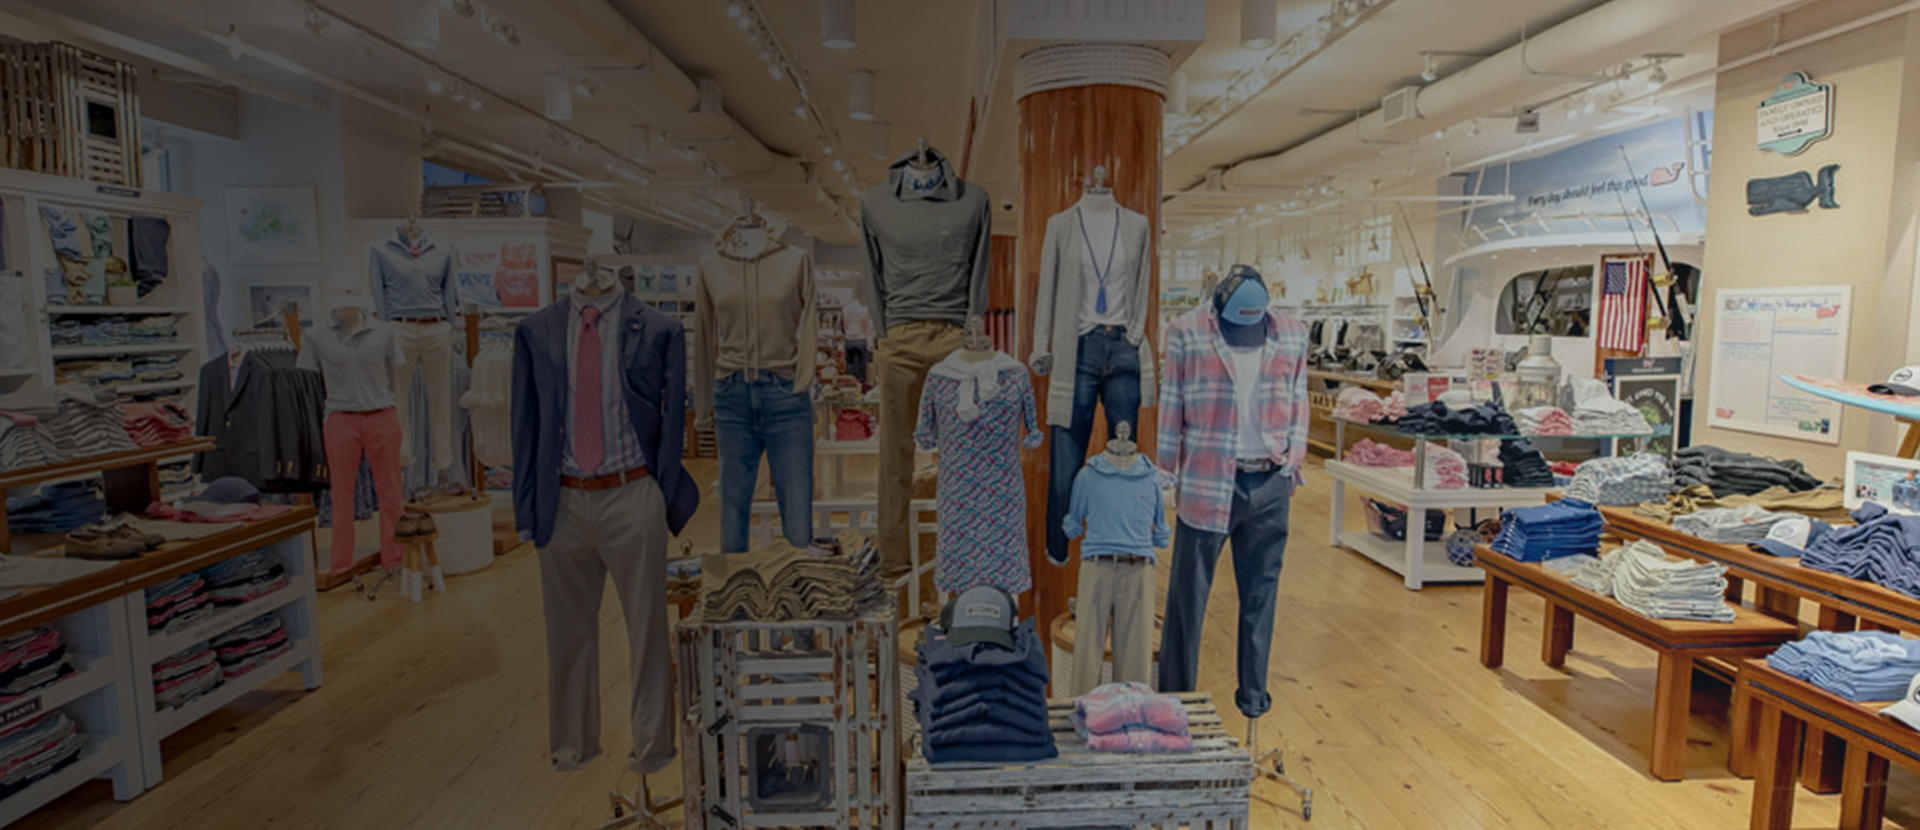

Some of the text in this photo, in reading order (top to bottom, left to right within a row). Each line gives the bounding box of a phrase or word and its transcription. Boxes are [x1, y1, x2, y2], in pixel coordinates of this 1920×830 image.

[1760, 94, 1824, 117] FAMILY OWNED
[1760, 104, 1824, 127] AND OPERATED
[1528, 173, 1648, 207] Every day should feel this good
[6, 701, 36, 720] PANTS
